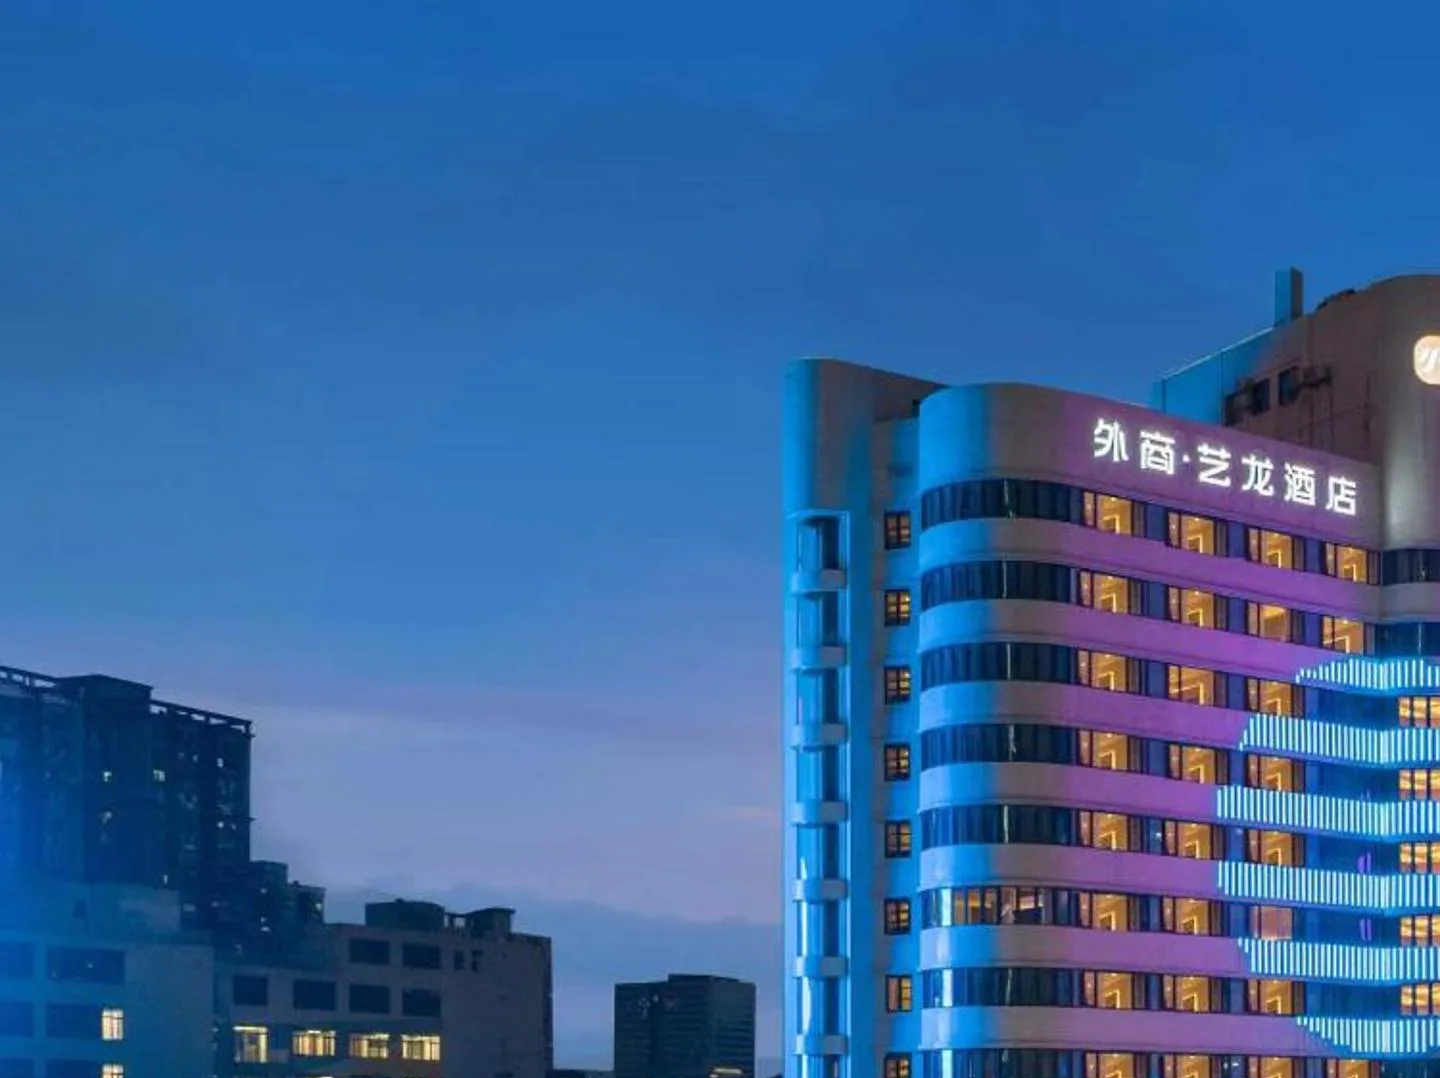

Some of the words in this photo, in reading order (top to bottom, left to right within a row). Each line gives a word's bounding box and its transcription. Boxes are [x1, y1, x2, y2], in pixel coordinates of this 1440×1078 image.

[1093, 418, 1357, 516] 外商·艺龙酒店
